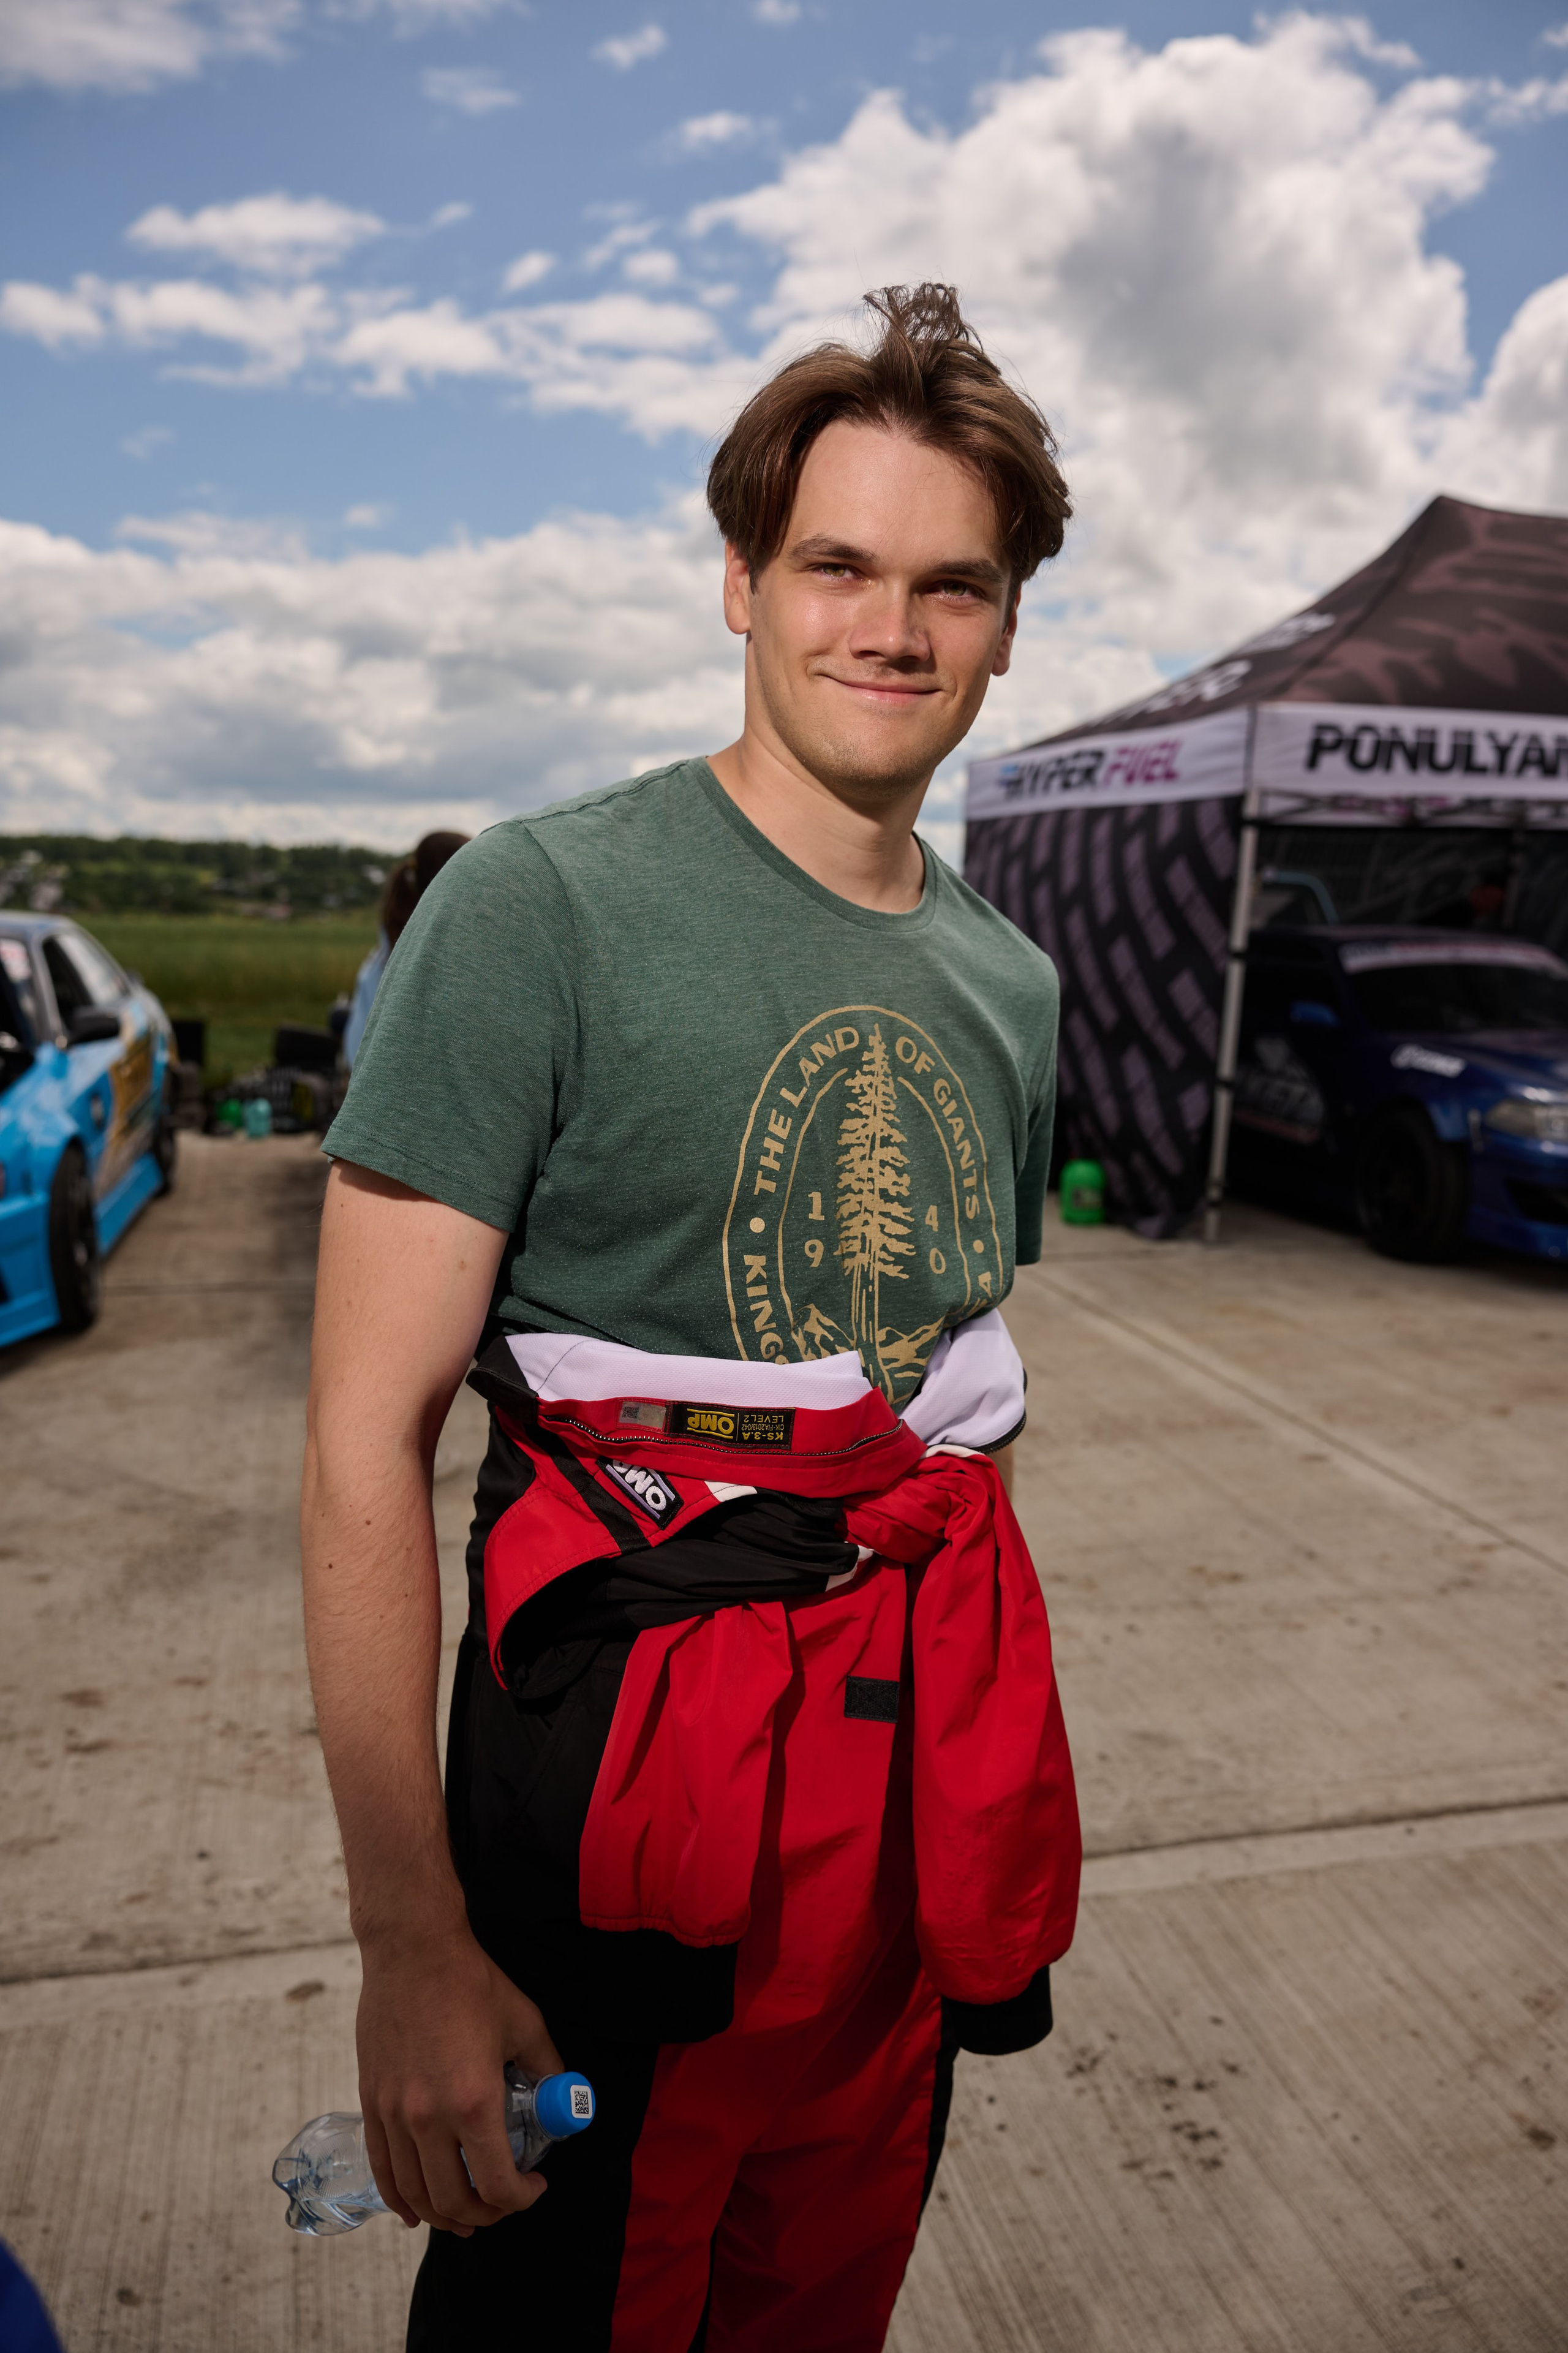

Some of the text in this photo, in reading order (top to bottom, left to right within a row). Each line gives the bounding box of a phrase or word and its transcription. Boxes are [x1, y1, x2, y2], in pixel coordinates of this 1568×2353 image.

[753, 1026, 981, 1220] THE LAND OF GIANTS
[687, 1413, 734, 1435] OMP
[742, 1432, 783, 1440] KS-3.A
